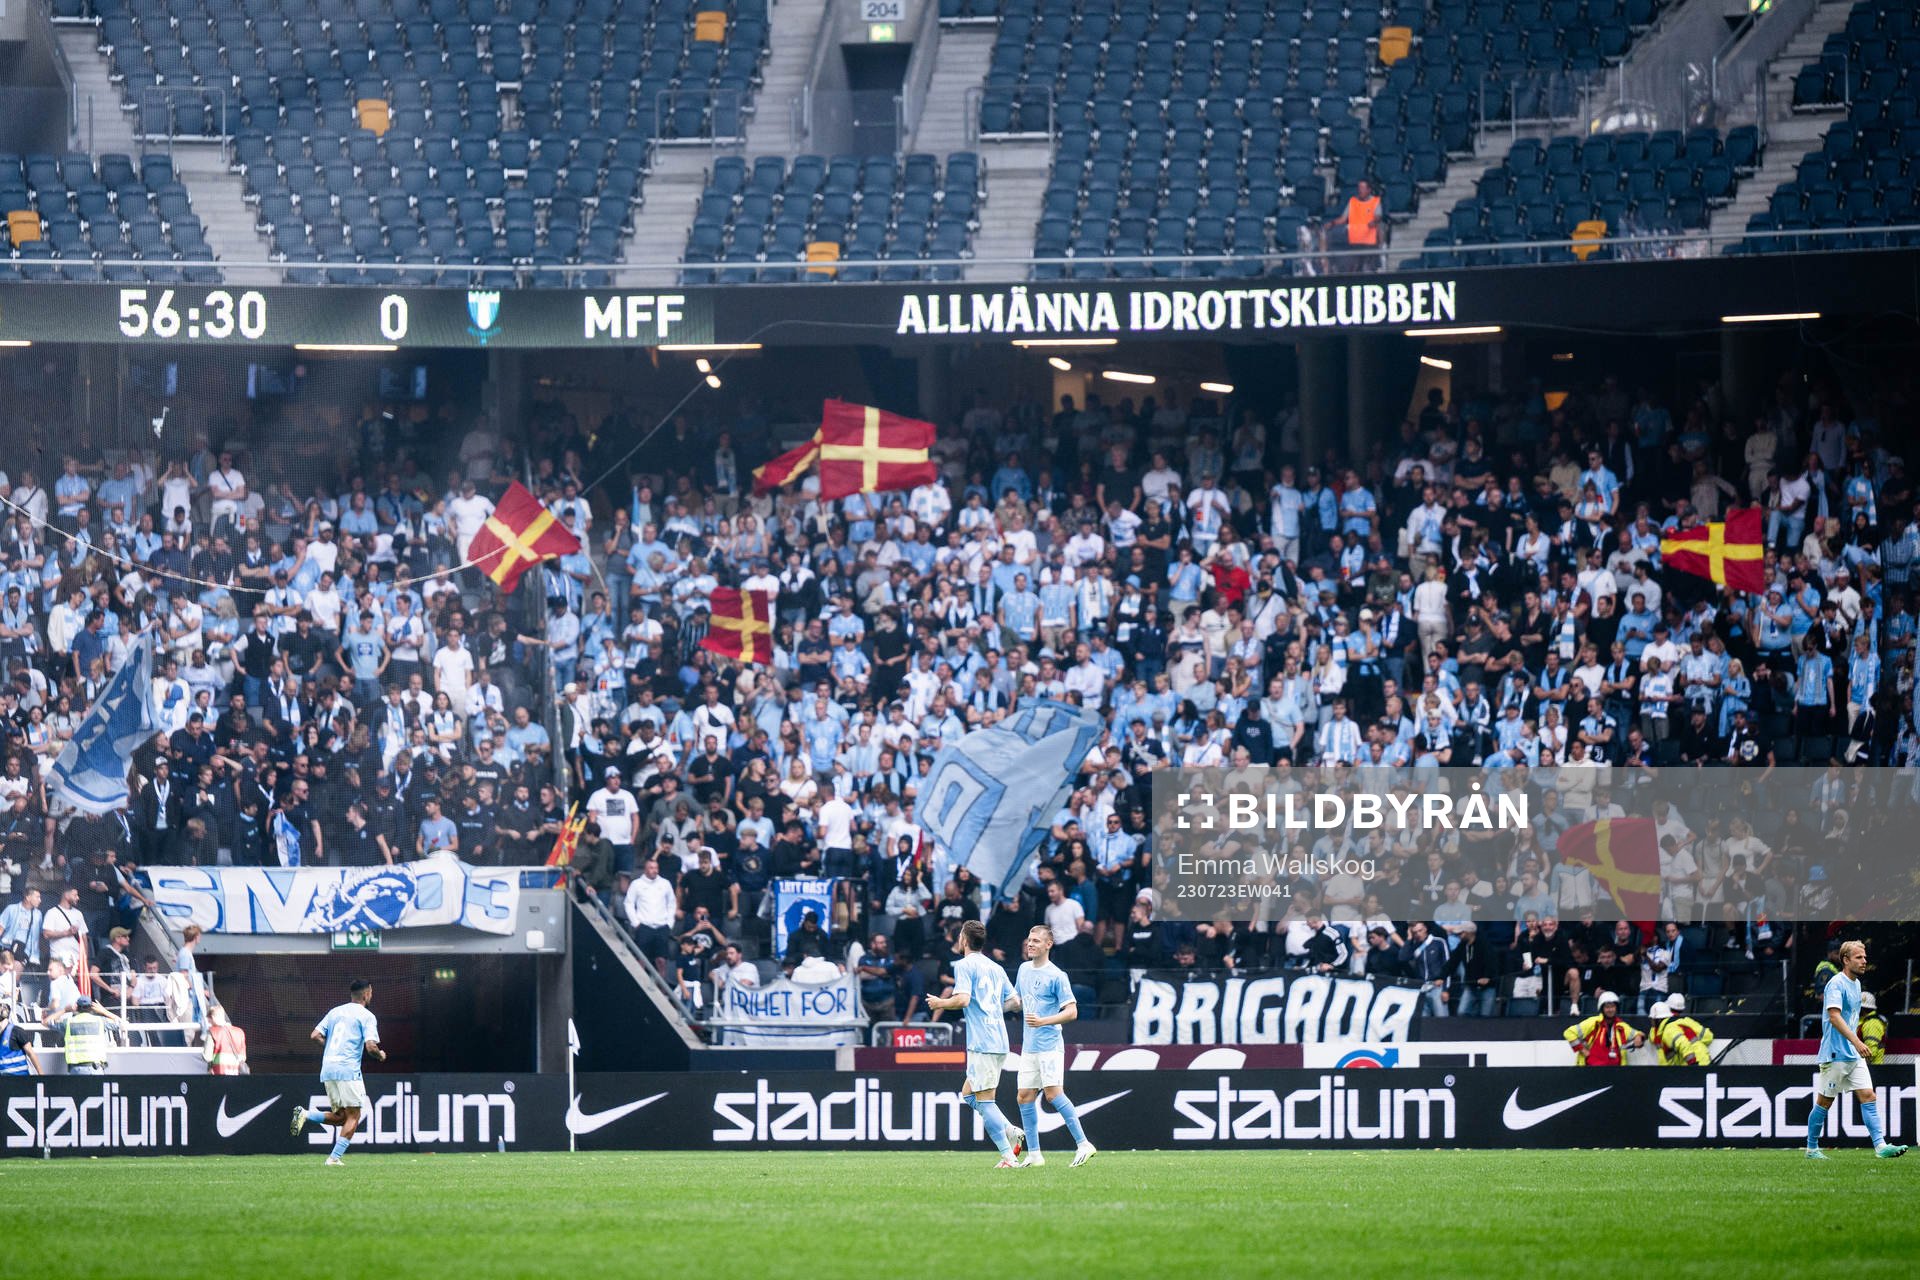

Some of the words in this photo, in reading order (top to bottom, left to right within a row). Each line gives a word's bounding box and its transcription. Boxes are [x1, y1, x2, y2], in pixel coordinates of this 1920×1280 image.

[867, 2, 899, 17] 204
[118, 289, 267, 340] 56:30
[380, 293, 408, 340] 0
[584, 296, 685, 340] MFF
[896, 286, 1120, 335] ALLMÄNNA
[1129, 280, 1457, 333] IDROTTSKLUBBEN
[802, 986, 848, 1017] FÖR
[1133, 974, 1422, 1045] BRIGADA
[6, 1082, 189, 1148] stadium
[308, 1081, 516, 1144] sadium
[1173, 1075, 1456, 1140] stadium
